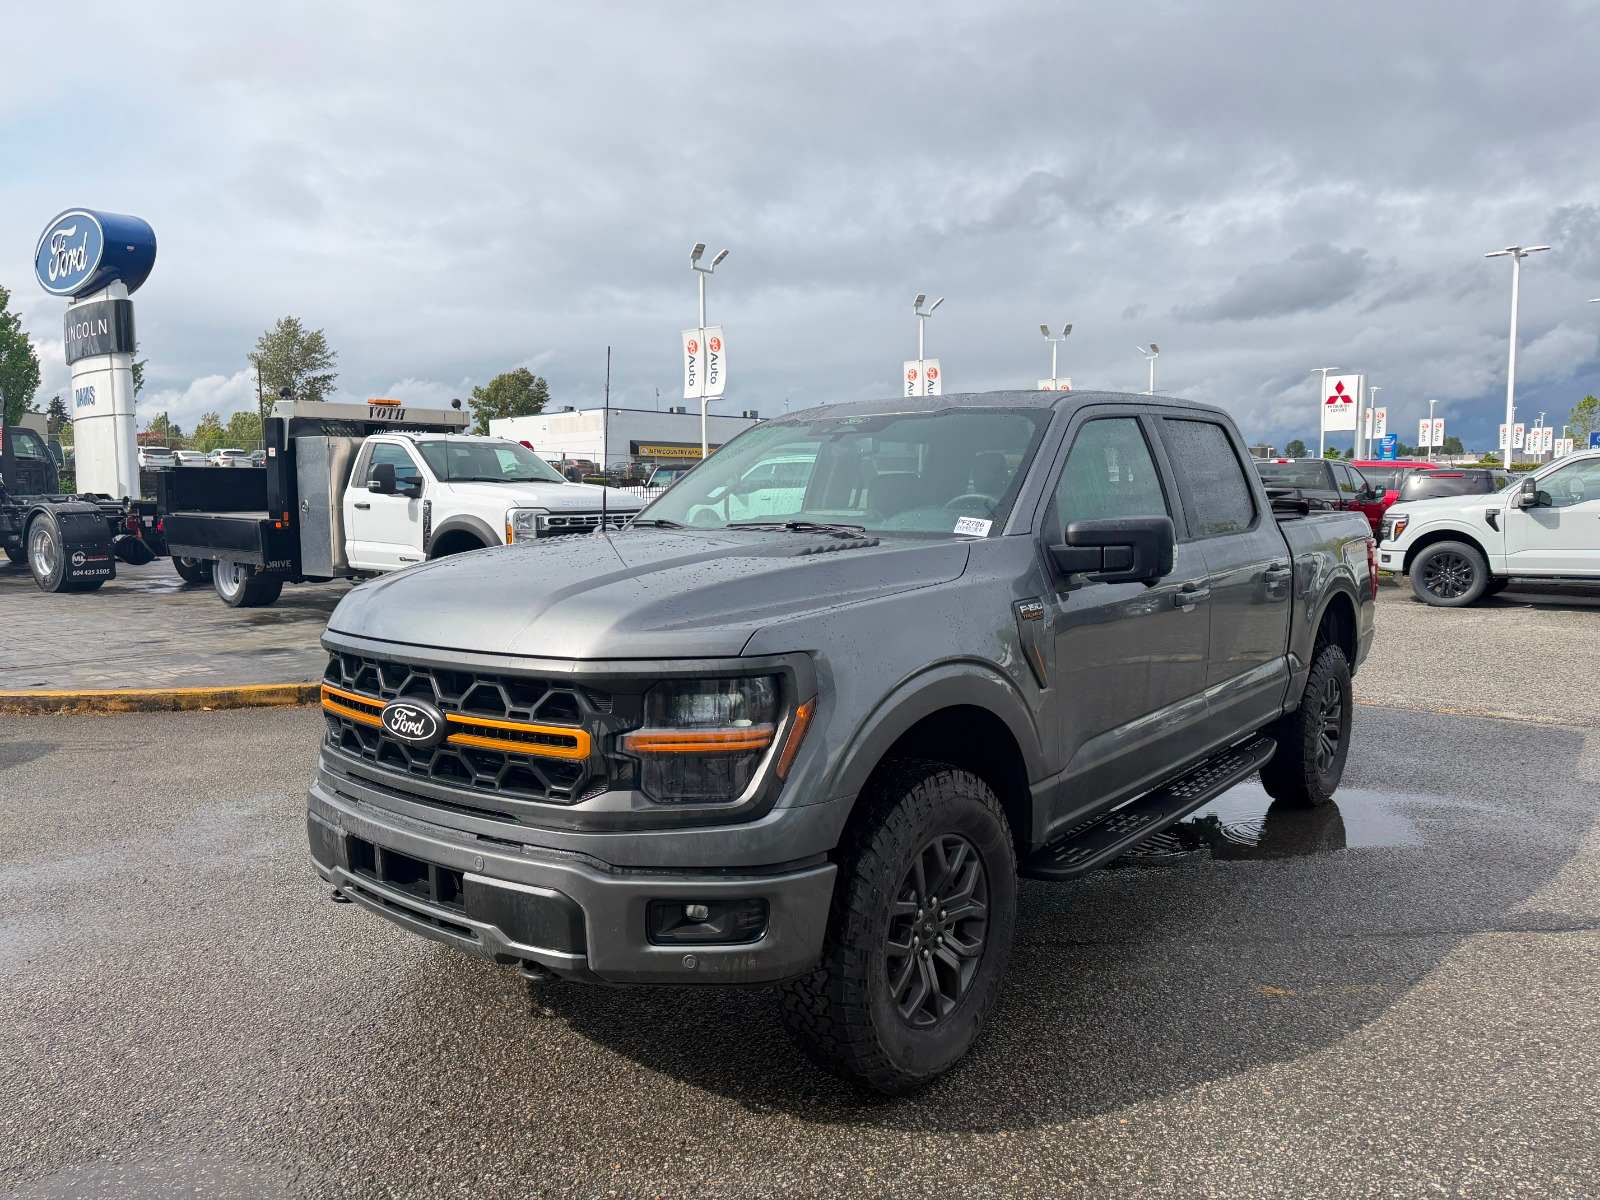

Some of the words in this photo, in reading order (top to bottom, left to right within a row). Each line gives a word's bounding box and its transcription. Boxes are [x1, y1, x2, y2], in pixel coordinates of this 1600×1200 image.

[48, 224, 88, 282] Ford
[65, 318, 108, 344] LINCOLN
[369, 406, 406, 420] VOTH
[391, 708, 425, 736] Ford
